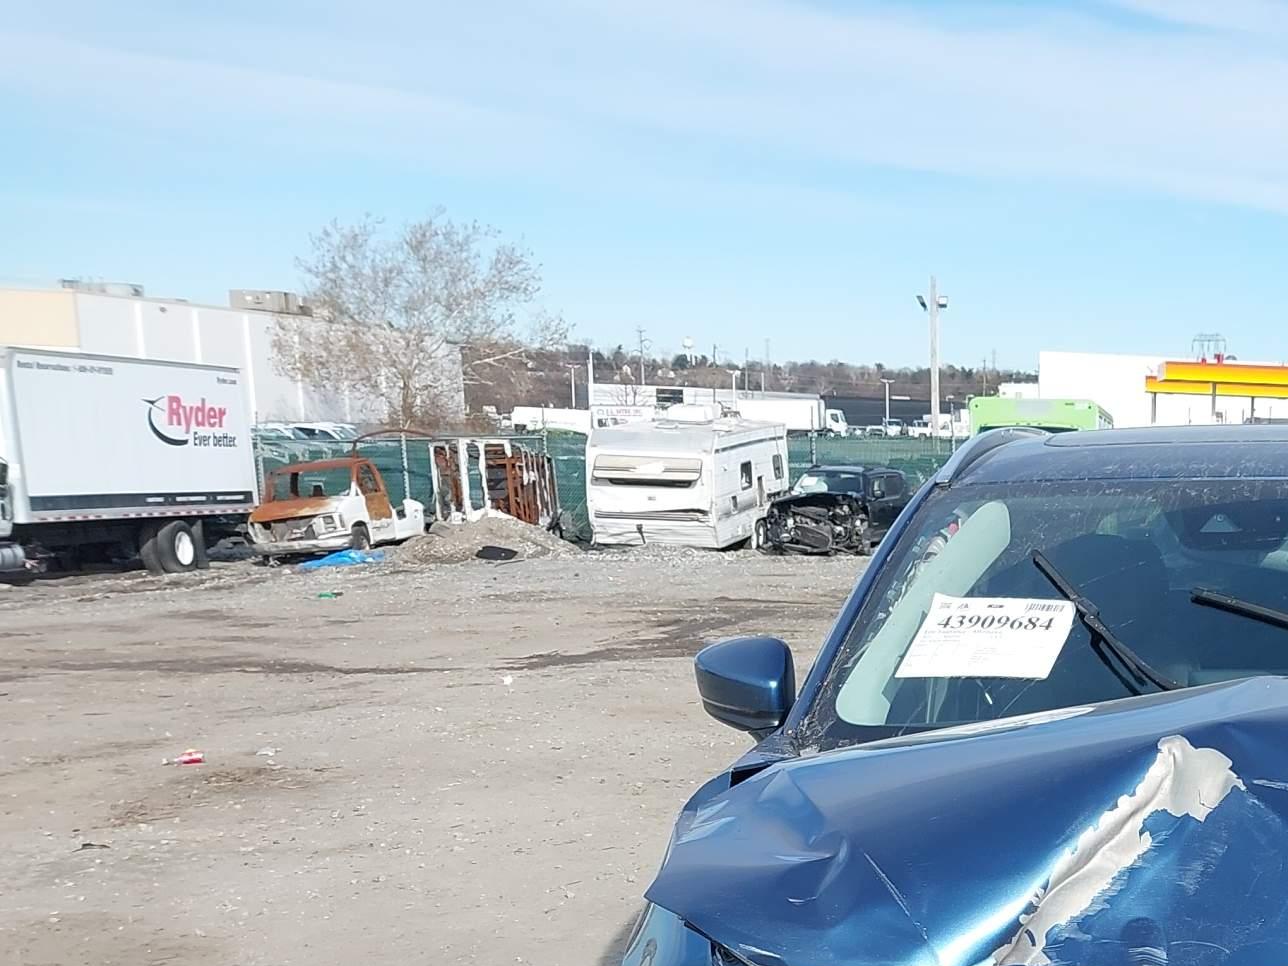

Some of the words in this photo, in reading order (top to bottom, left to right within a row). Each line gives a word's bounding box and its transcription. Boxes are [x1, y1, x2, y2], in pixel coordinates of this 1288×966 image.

[167, 395, 227, 435] Ryder
[193, 431, 212, 447] Ever
[937, 614, 1055, 631] 43909684
